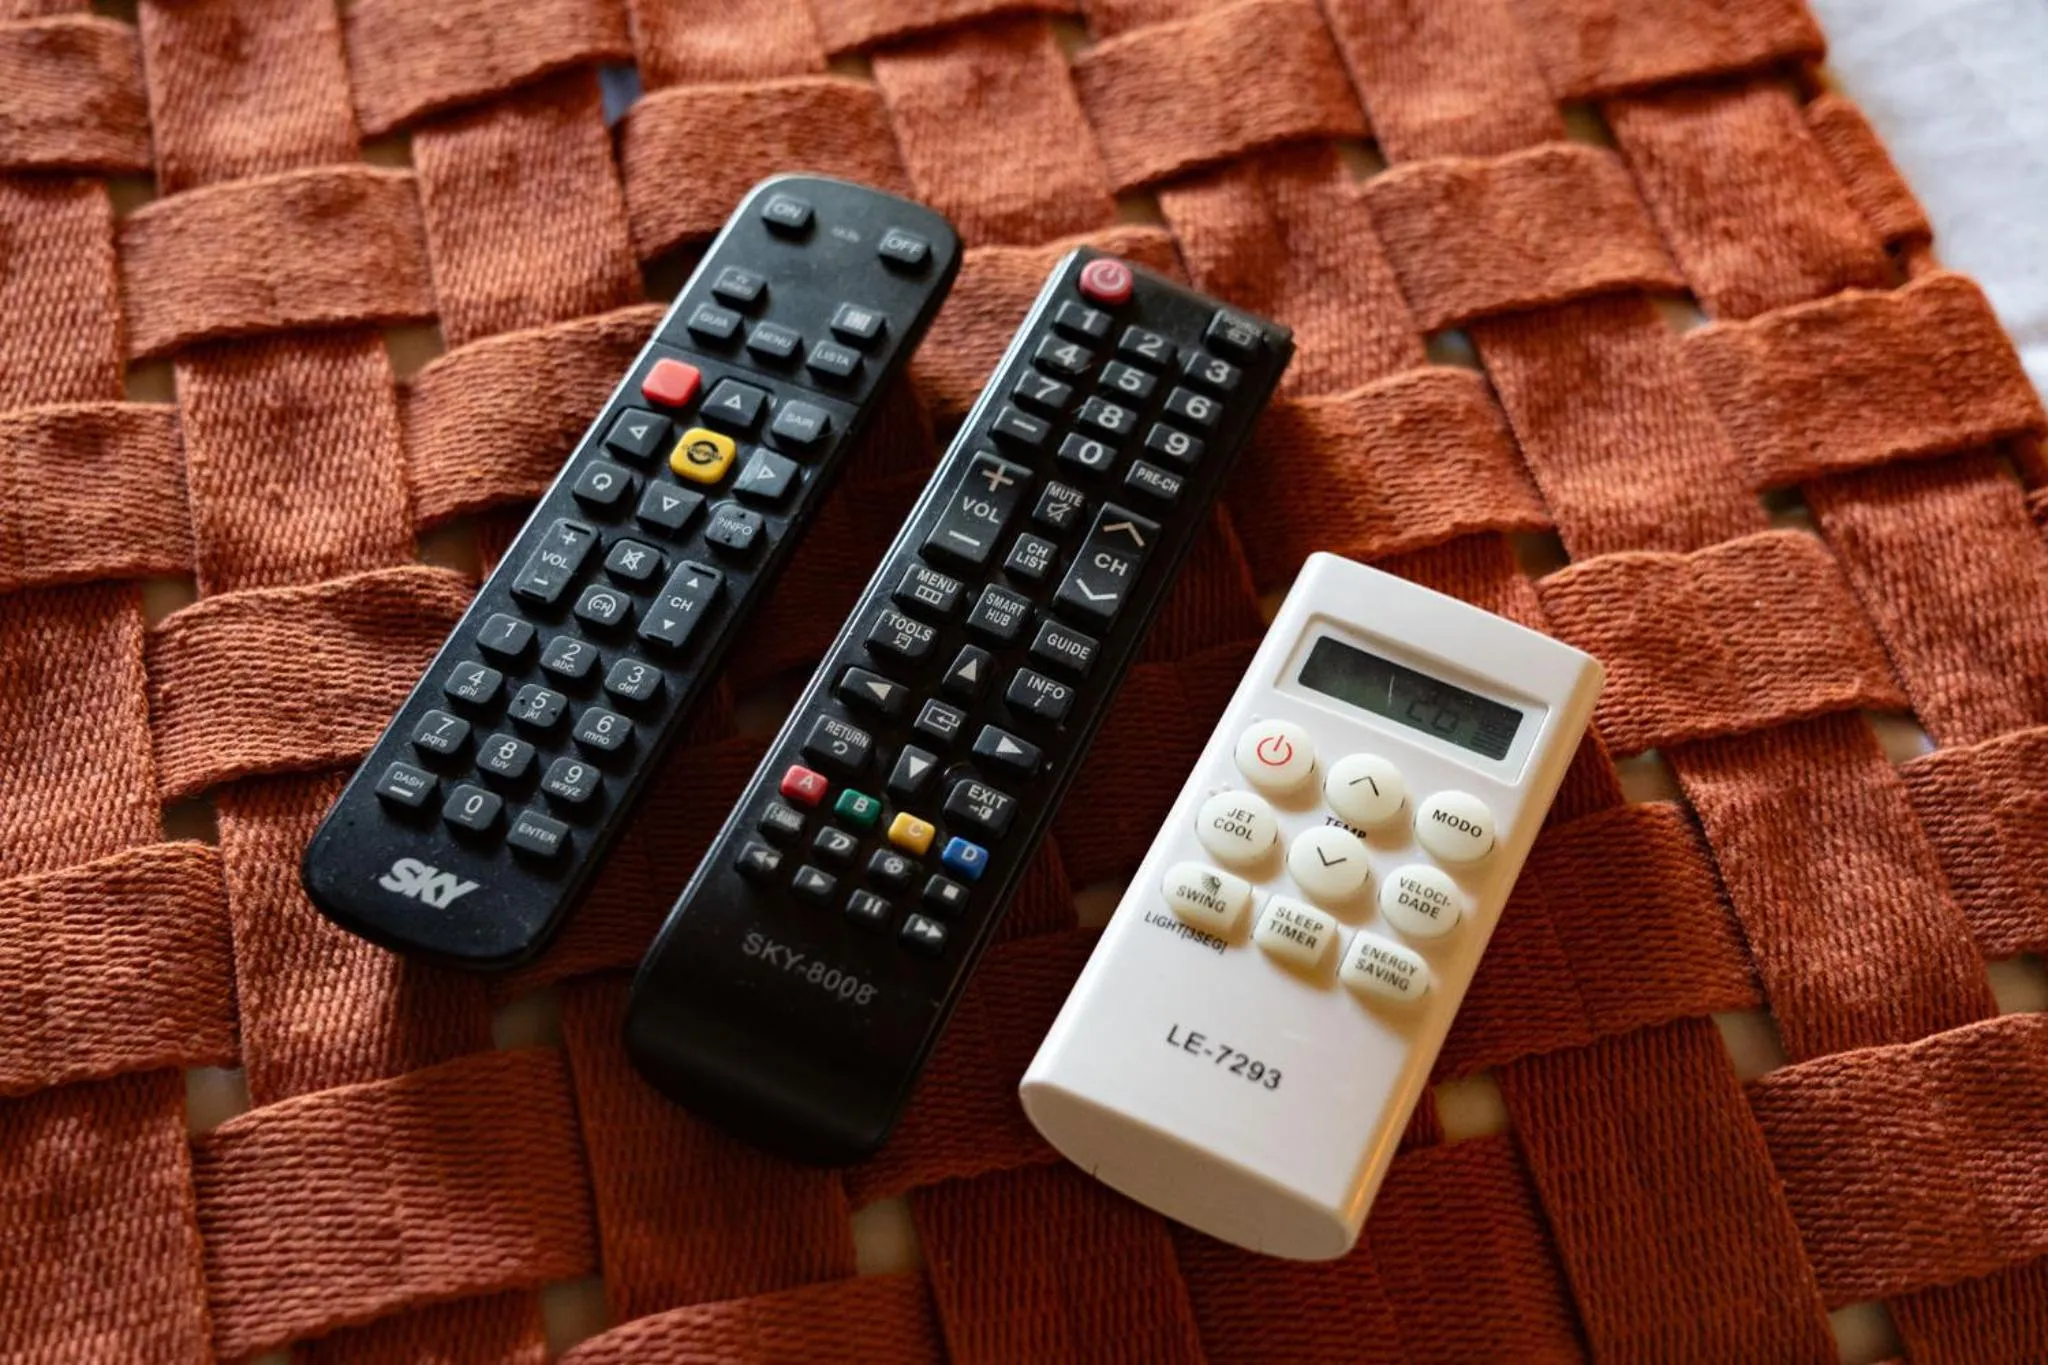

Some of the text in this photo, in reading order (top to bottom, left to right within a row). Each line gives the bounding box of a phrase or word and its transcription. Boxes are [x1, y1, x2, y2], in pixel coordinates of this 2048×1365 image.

[772, 201, 801, 219] ON
[886, 237, 923, 255] OFF
[1081, 310, 1097, 331] 1
[758, 328, 792, 349] MENU
[1136, 332, 1165, 358] 2
[816, 348, 850, 367] LISTA
[1054, 344, 1077, 366] 4
[1118, 367, 1142, 392] 5
[1204, 359, 1231, 385] 3
[1033, 377, 1060, 401] 7
[1097, 404, 1124, 430] 8
[1185, 395, 1212, 420] 6
[1079, 441, 1104, 465] 0
[1164, 431, 1190, 457] 9
[1135, 467, 1181, 494] PRE-CH
[1048, 484, 1085, 508] MUTE
[962, 496, 1000, 524] VOL
[541, 551, 569, 569] VOL
[1027, 541, 1049, 558] CH
[1016, 553, 1049, 572] LIST
[1095, 552, 1129, 577] CH
[916, 569, 959, 595] MENU
[592, 600, 613, 612] CH
[669, 597, 694, 612] CH
[985, 592, 1026, 617] SMART
[887, 613, 934, 642] TOOLS
[985, 609, 1012, 628] HUB
[504, 621, 518, 638] 1
[561, 643, 581, 661] 2
[1047, 632, 1091, 661] GUIDE
[552, 658, 575, 672] abc
[627, 665, 645, 683] 3
[468, 669, 486, 687] 4
[618, 681, 639, 695] def
[1027, 675, 1066, 700] INFO
[458, 684, 479, 698] ghi
[531, 691, 551, 709] 5
[522, 707, 542, 721] jkl
[596, 714, 615, 733] 6
[435, 716, 456, 735] 7
[825, 720, 870, 748] RETURN
[420, 732, 449, 749] pqrs
[583, 730, 610, 745] mno
[499, 741, 518, 760] 8
[491, 756, 510, 771] tuv
[393, 770, 425, 790] DASH
[563, 765, 583, 784] 9
[800, 775, 814, 790] A
[550, 780, 582, 798] wxyz
[968, 783, 1008, 810] EXIT
[464, 794, 484, 814] 0
[853, 796, 869, 813] B
[1228, 807, 1256, 824] JET
[1432, 808, 1483, 839] MODO
[518, 821, 558, 845] ENTER
[909, 822, 925, 838] C
[1213, 817, 1254, 842] COOL
[962, 846, 978, 862] D
[378, 857, 481, 910] SKY
[1399, 876, 1453, 907] VELOCI-
[1176, 884, 1226, 914] SWING
[1397, 894, 1442, 920] DADE
[1275, 905, 1325, 933] SLEEP
[1268, 919, 1318, 949] TIMER
[742, 932, 877, 1005] SKY-8008
[1361, 943, 1419, 977] ENERGY
[1355, 958, 1410, 993] SAVING
[1166, 1023, 1283, 1091] LE-7293
